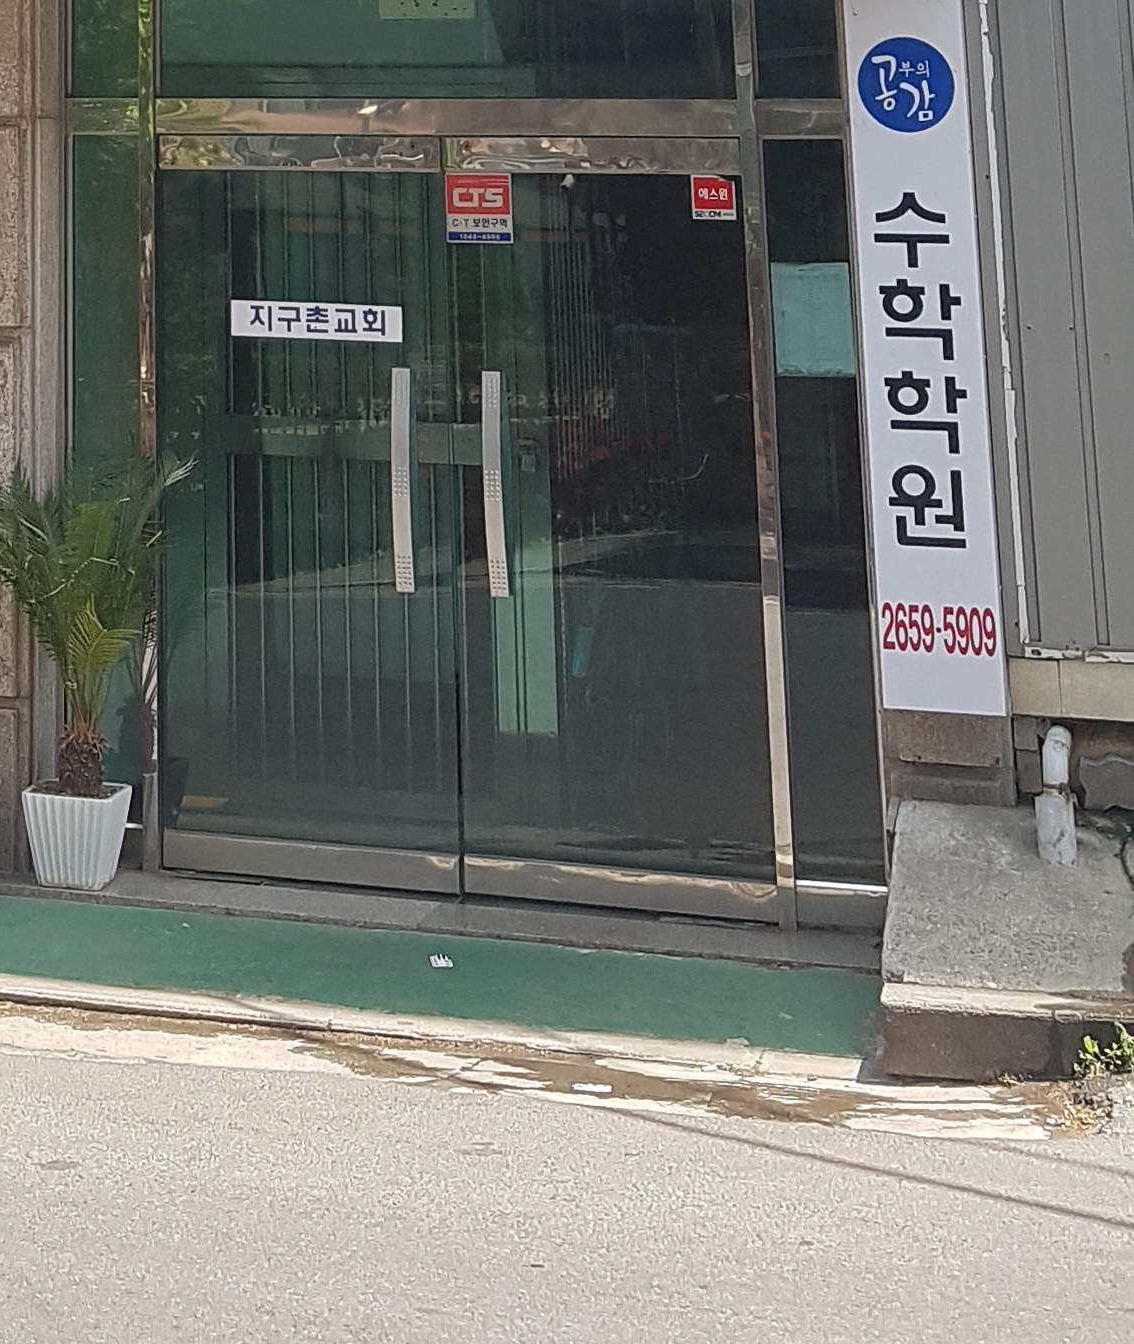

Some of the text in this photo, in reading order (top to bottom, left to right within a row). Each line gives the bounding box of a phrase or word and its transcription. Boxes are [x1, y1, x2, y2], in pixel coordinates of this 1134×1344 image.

[452, 187, 504, 208] CTS
[248, 306, 388, 338] 지구촌교회
[873, 190, 968, 550] 수학학원
